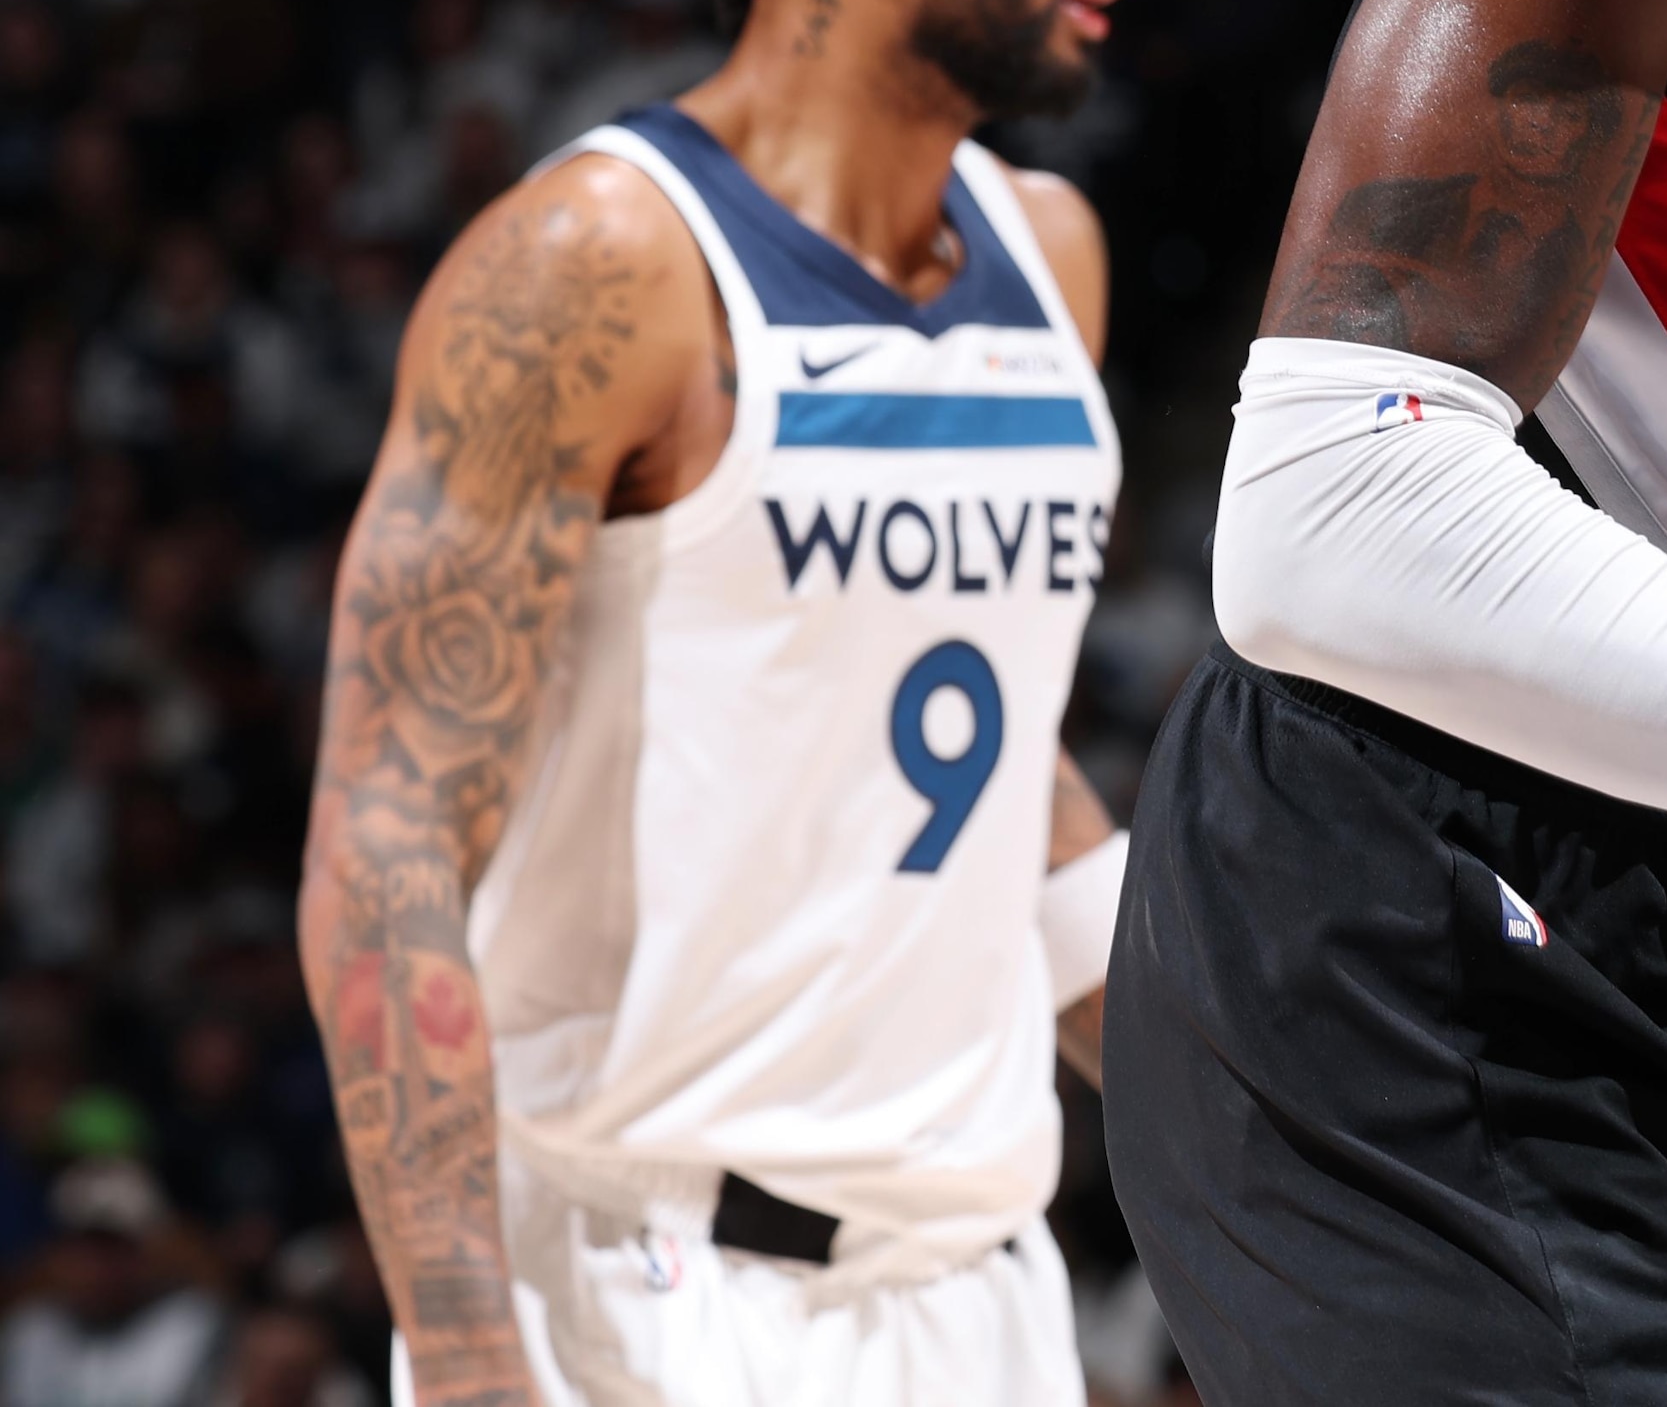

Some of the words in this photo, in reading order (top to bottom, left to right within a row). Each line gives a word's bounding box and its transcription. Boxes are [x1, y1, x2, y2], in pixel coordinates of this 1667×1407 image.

[763, 498, 1107, 593] WOLVES
[890, 639, 1003, 873] 9
[1508, 918, 1532, 940] NBA
